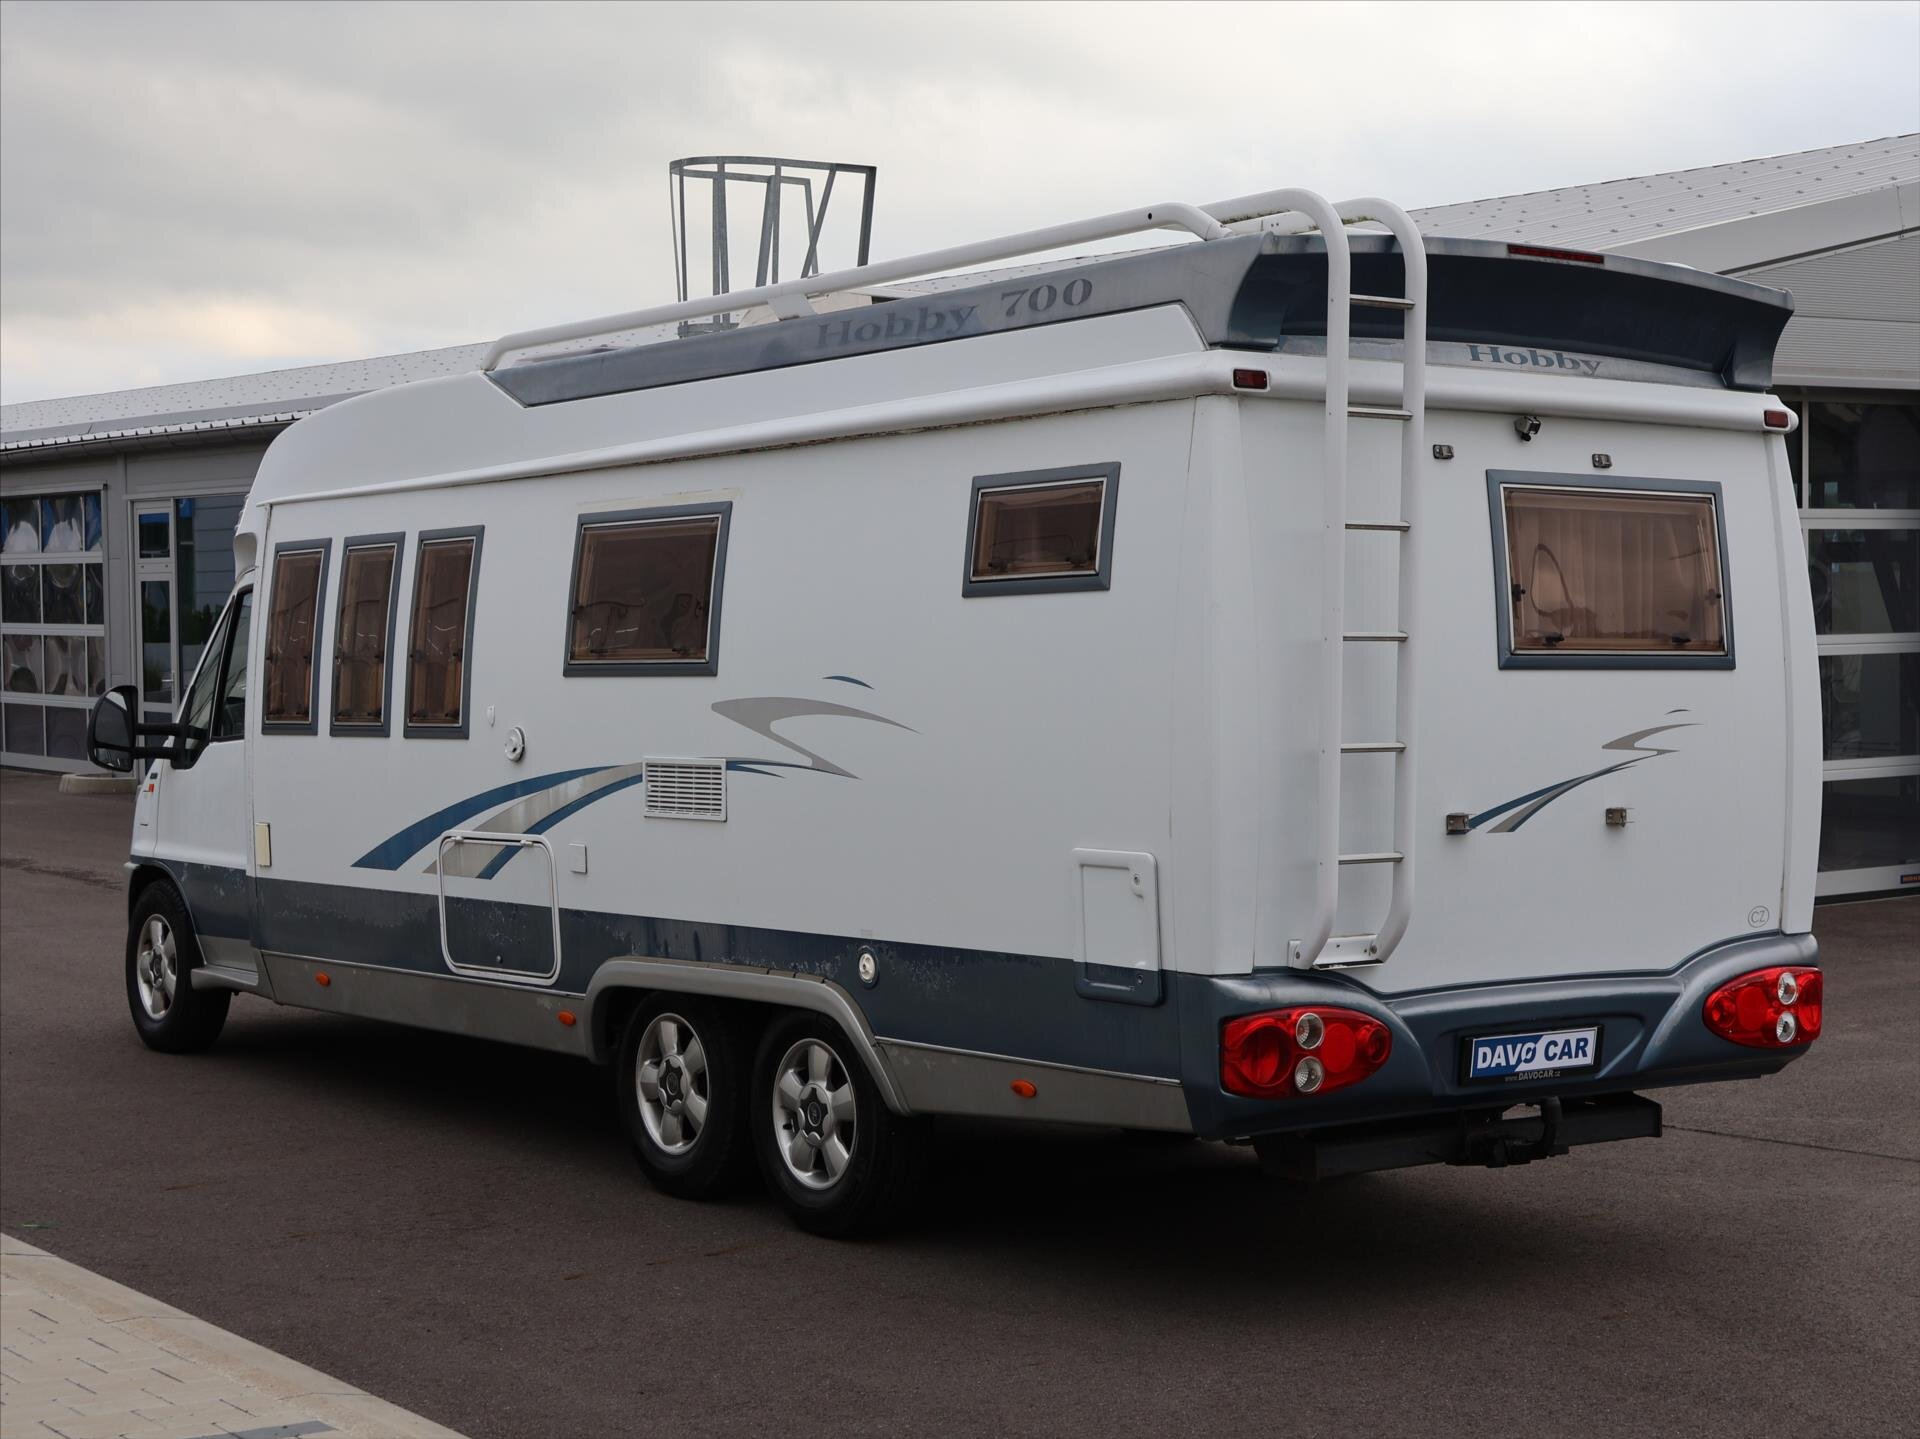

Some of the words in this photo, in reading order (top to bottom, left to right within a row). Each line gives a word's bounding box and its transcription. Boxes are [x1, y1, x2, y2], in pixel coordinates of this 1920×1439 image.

[816, 302, 980, 347] Hobby
[1000, 278, 1093, 318] 700
[1466, 343, 1603, 379] Hobby
[1750, 910, 1766, 923] CZ
[1476, 1042, 1538, 1069] DAVO
[1544, 1037, 1589, 1062] CAR
